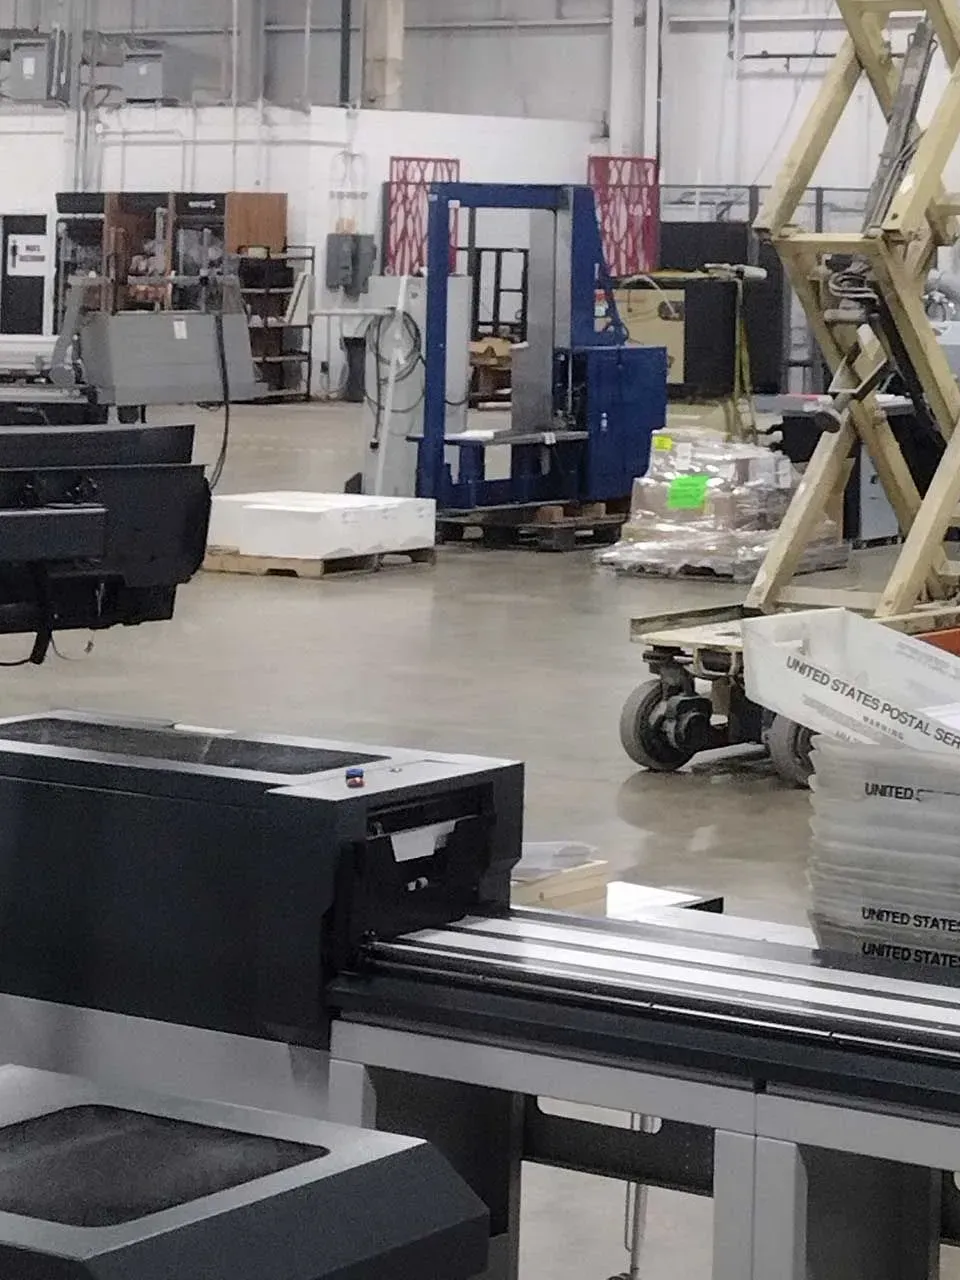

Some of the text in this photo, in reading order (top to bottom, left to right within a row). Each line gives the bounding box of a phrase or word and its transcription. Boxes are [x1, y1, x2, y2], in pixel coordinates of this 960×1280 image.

[786, 655, 830, 686] UNITED
[830, 678, 881, 712] STATES
[880, 703, 932, 737] POSTAL
[864, 782, 914, 801] UNITED
[861, 907, 910, 925] UNITED
[861, 942, 910, 961] UNITED
